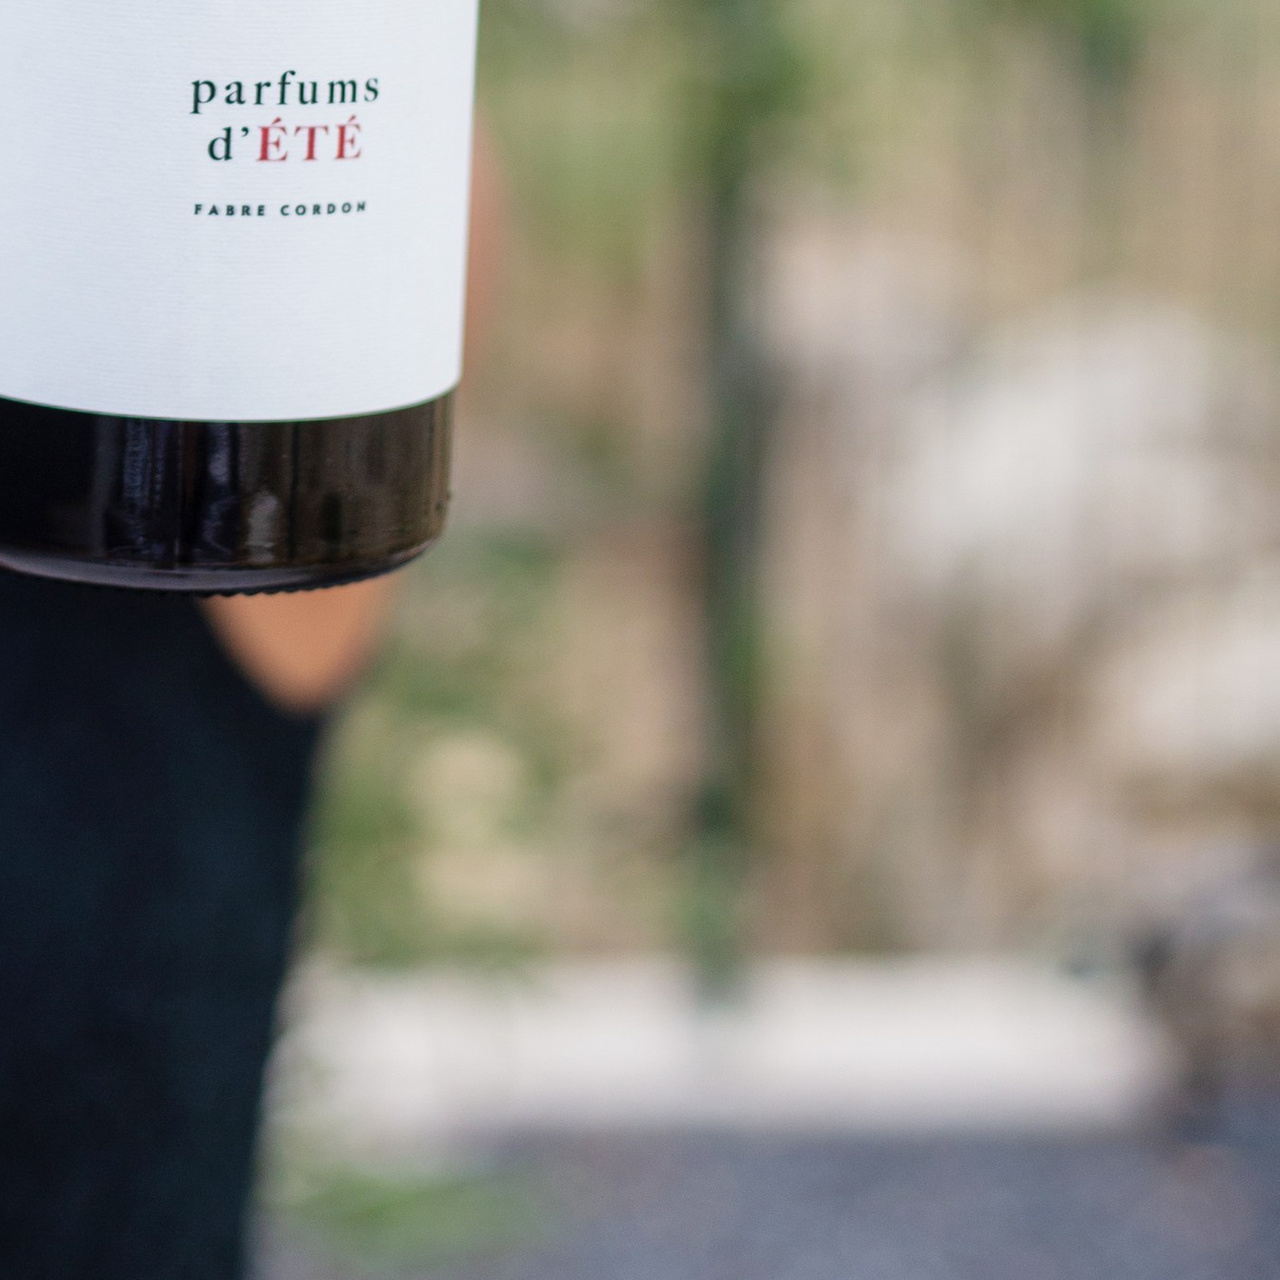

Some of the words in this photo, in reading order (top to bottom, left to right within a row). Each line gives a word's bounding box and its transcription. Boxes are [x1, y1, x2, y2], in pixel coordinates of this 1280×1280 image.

[189, 69, 380, 115] parfums
[207, 114, 362, 163] d’ÉTÉ
[193, 203, 266, 217] FABRE
[280, 200, 367, 217] CORDON
